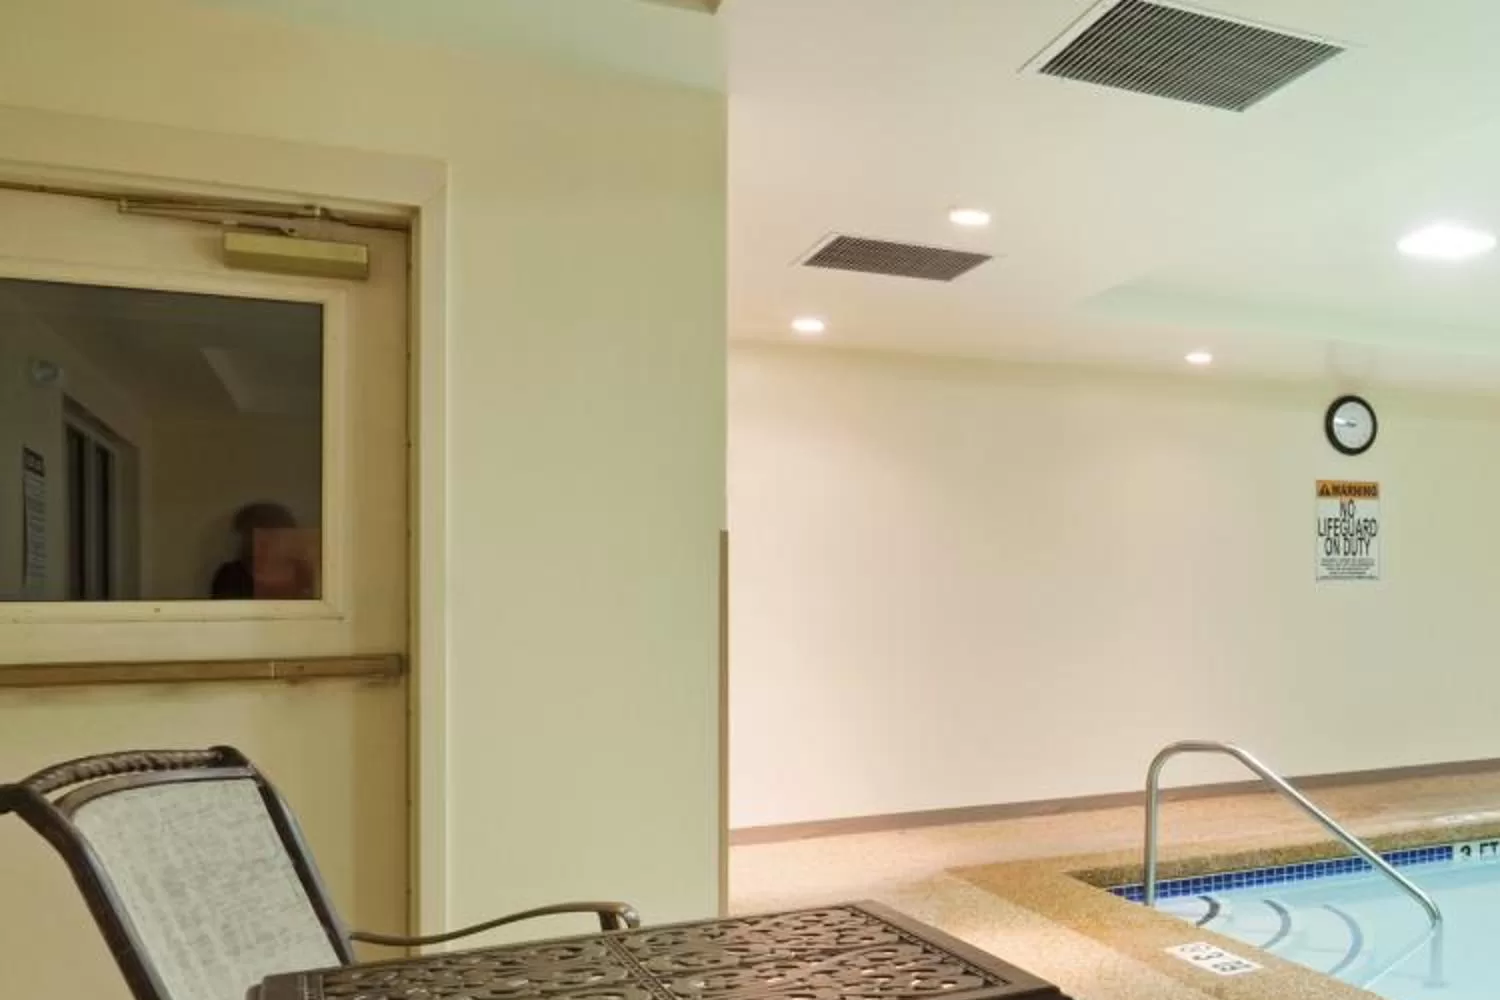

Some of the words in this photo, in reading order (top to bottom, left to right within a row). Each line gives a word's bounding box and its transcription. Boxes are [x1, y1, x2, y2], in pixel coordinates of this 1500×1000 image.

[1340, 499, 1356, 518] NO
[1318, 517, 1377, 537] LIFEGUARD
[1324, 537, 1340, 556] ON
[1343, 537, 1371, 556] DUTY
[1480, 841, 1499, 859] FT
